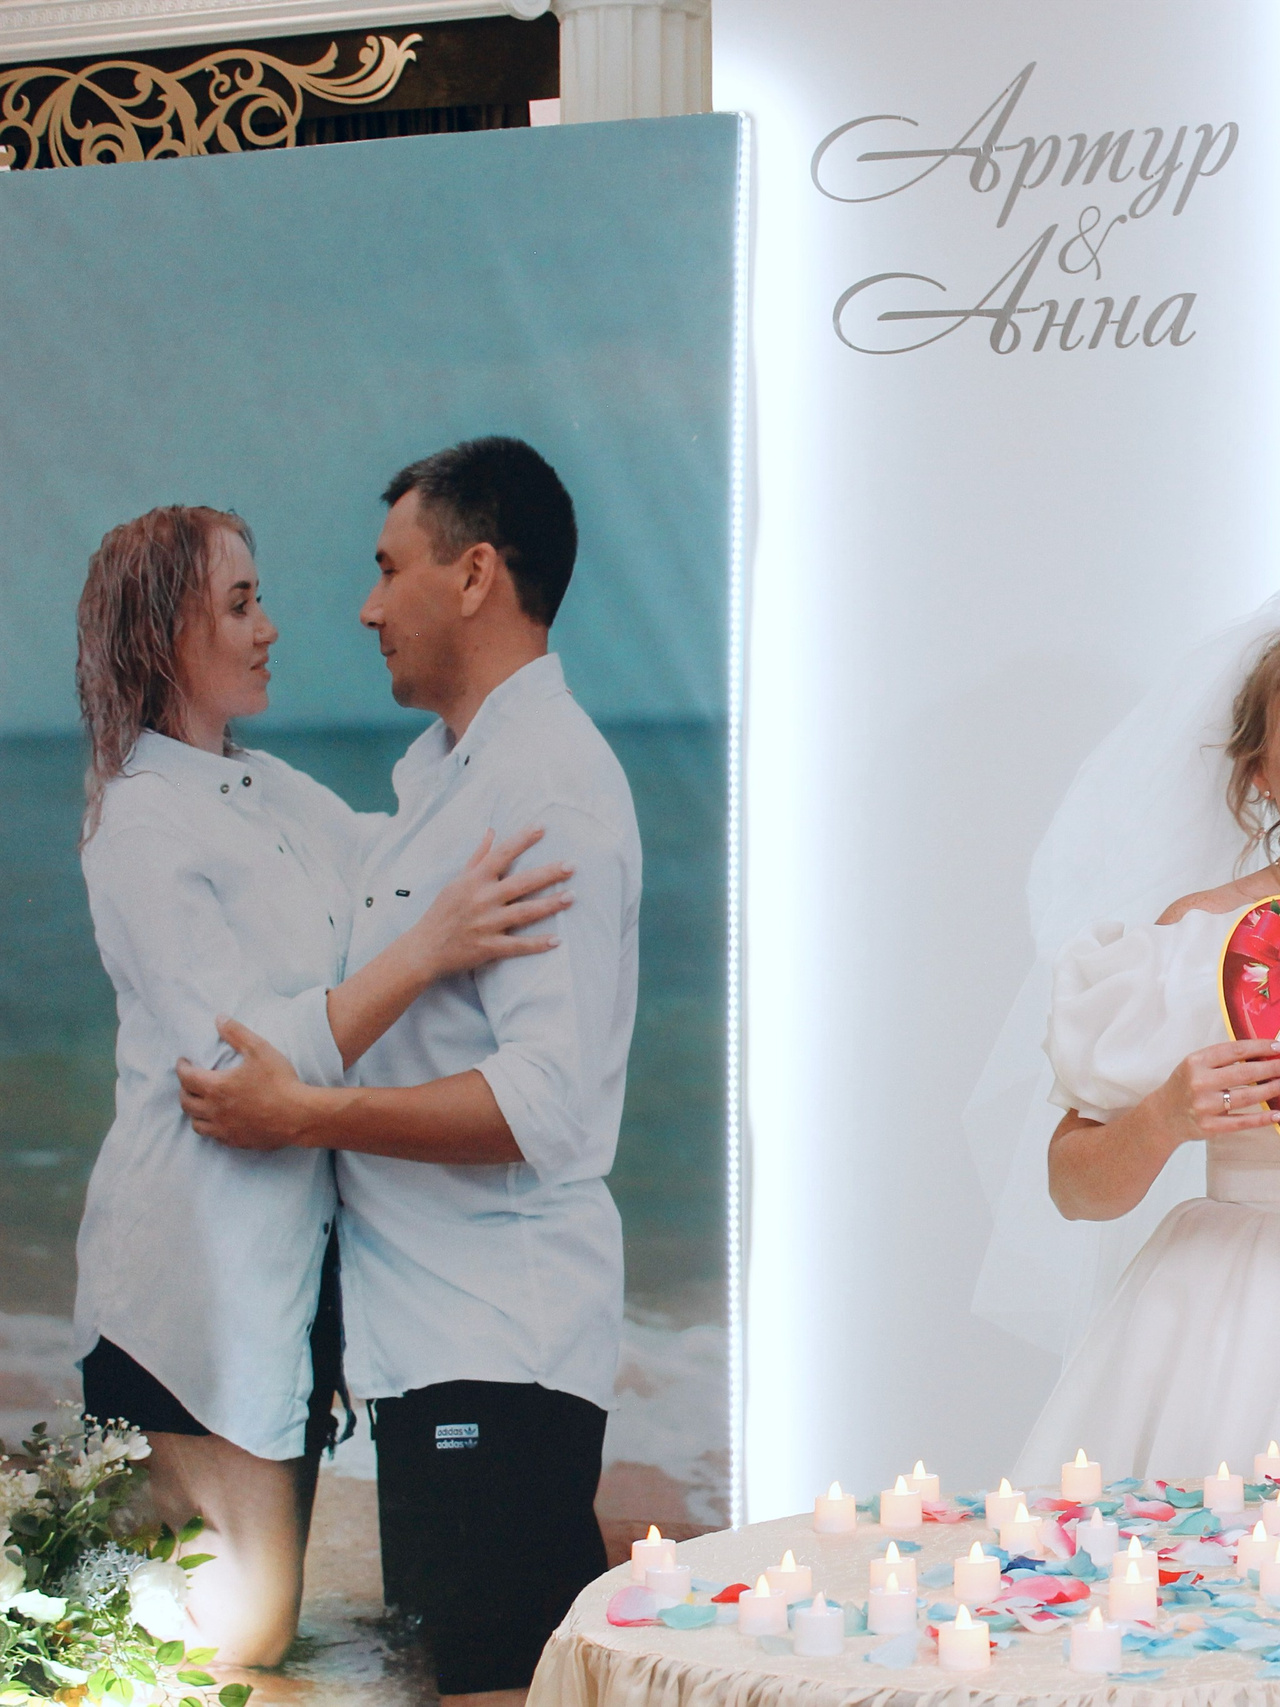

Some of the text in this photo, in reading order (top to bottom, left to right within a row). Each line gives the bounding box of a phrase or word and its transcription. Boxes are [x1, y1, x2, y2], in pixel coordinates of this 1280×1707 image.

[810, 60, 1240, 229] Артур
[832, 222, 1198, 355] Анна
[1057, 205, 1128, 281] &
[437, 1428, 463, 1436] adidas
